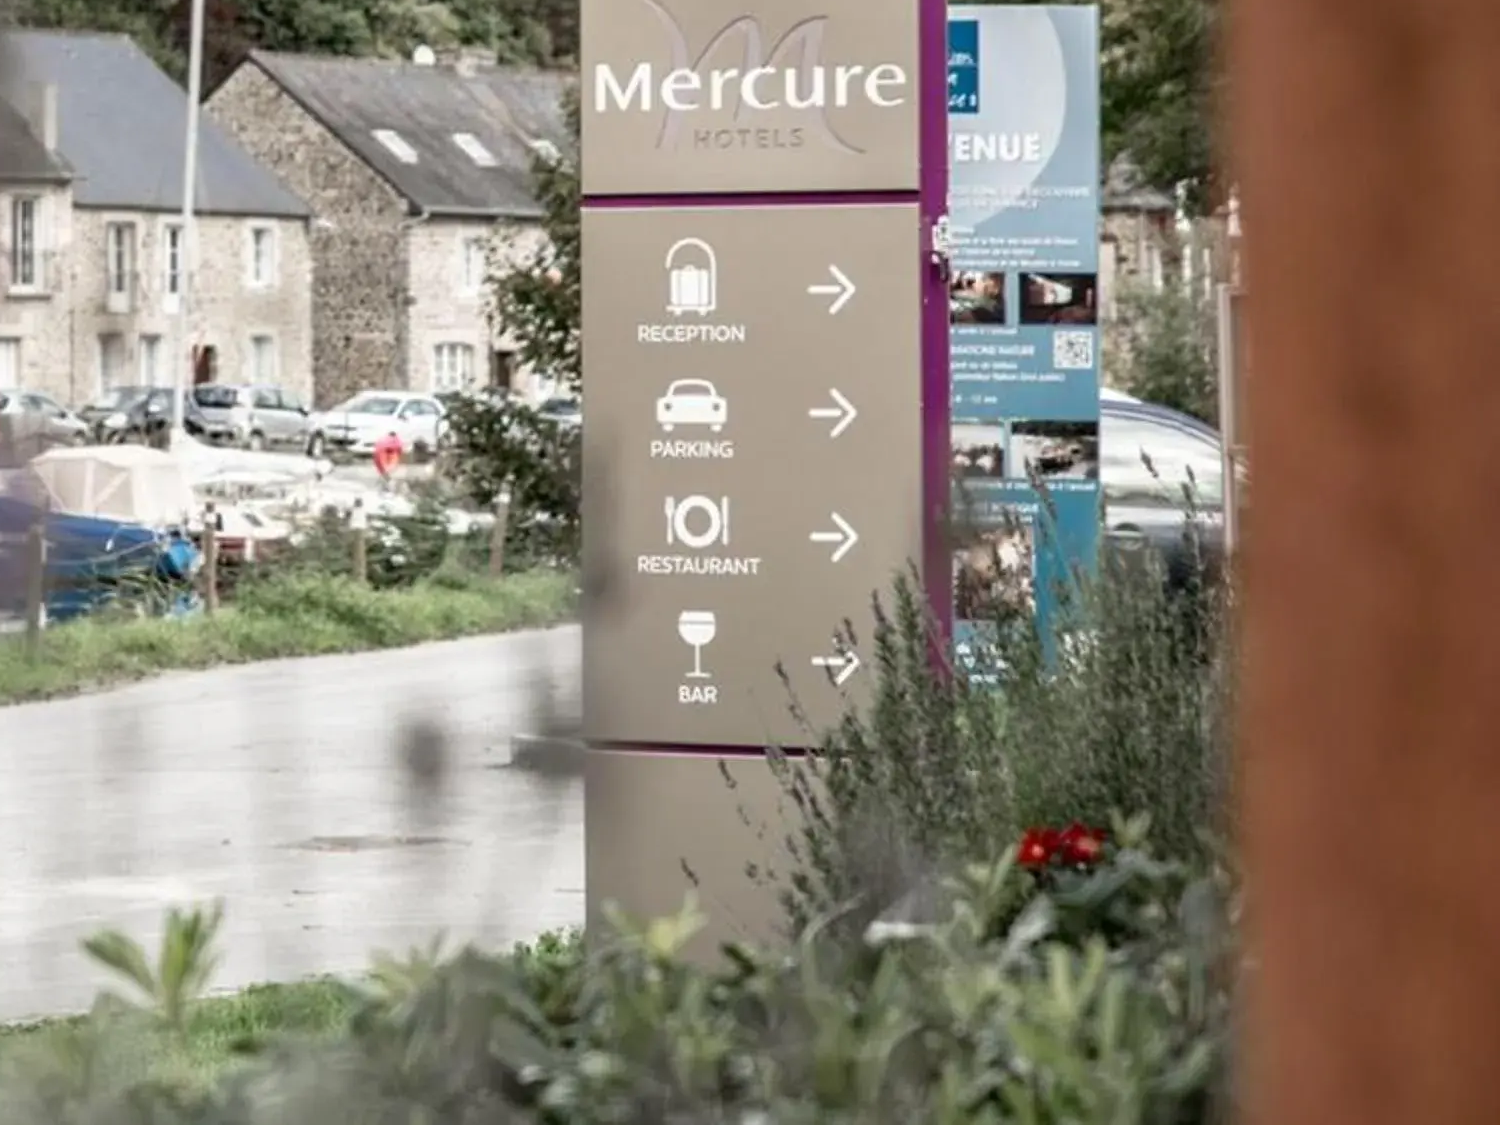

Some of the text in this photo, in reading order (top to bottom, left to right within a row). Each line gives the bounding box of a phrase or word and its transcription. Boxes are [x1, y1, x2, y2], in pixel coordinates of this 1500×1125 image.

[594, 62, 907, 113] Mercure
[693, 127, 804, 149] HOTELS
[952, 131, 1041, 163] ENUE
[637, 324, 746, 343] RECEPTION
[650, 440, 734, 459] PARKING
[637, 554, 761, 575] RESTAURANT
[678, 685, 718, 704] BAR
